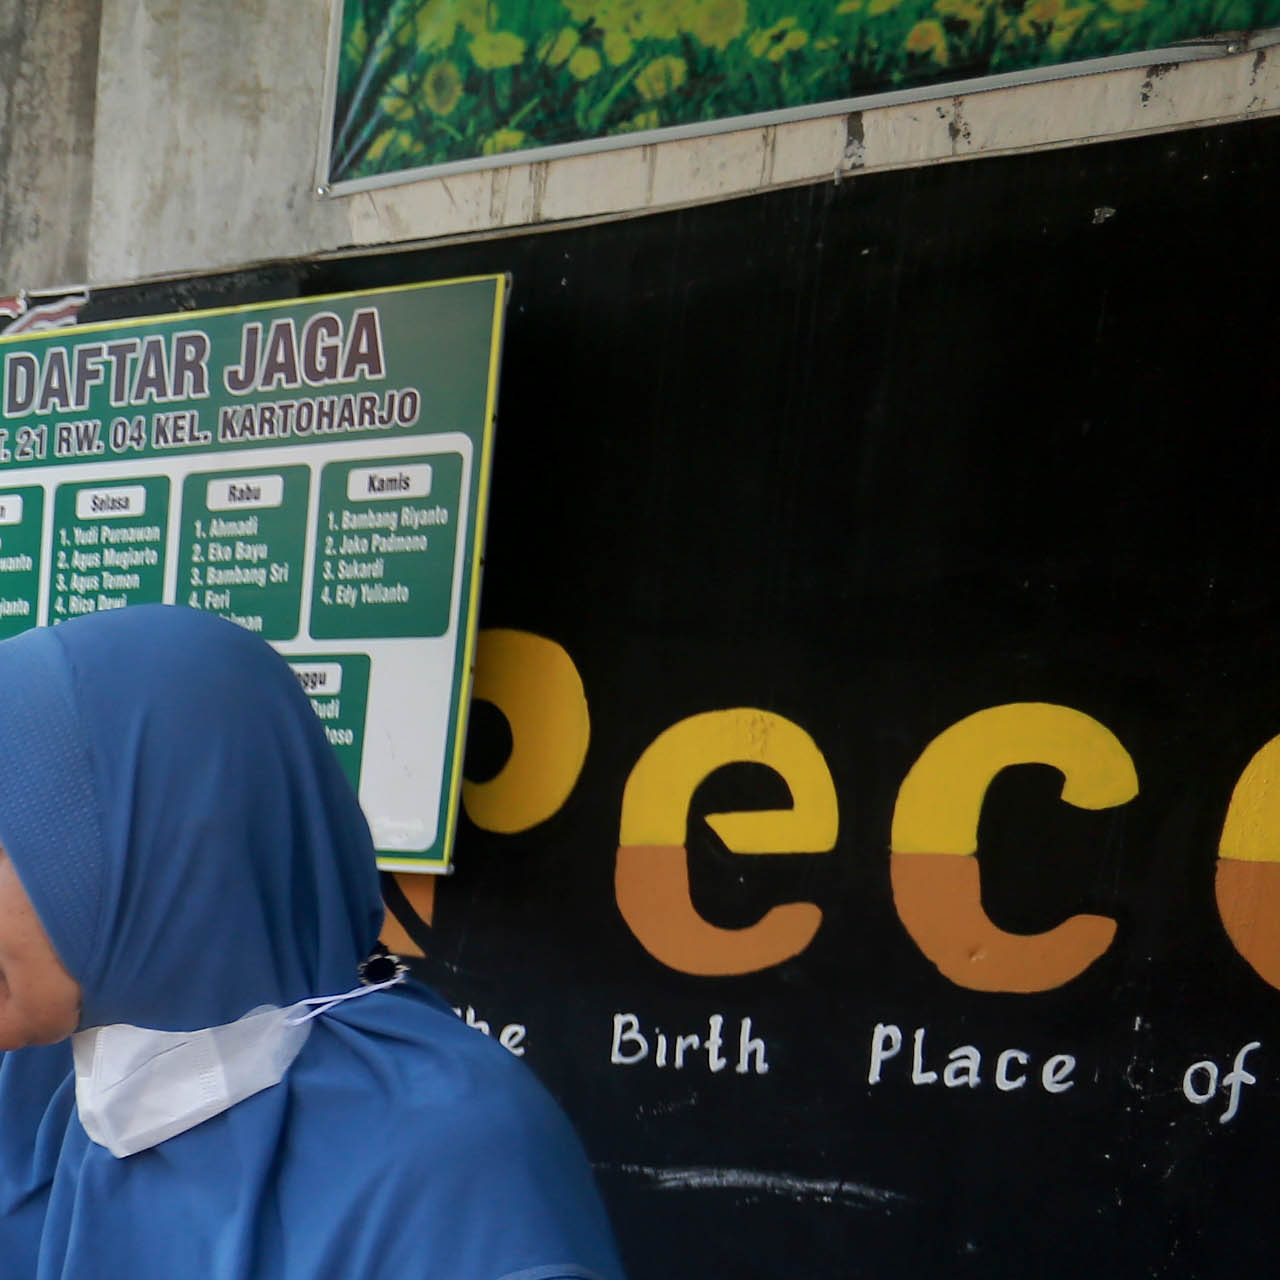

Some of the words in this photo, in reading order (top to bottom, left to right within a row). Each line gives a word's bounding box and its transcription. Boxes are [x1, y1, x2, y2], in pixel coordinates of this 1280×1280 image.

[4, 331, 209, 417] DAFTAR
[224, 308, 385, 395] JAGA
[16, 424, 46, 461] 21
[55, 420, 104, 456] RW.
[111, 417, 145, 453] 04
[152, 410, 211, 448] KEL.
[218, 388, 420, 442] KARTOHARJO
[228, 485, 261, 502] Rabu
[368, 474, 410, 493] Kamis
[327, 511, 338, 530] 1.
[341, 508, 398, 531] Bambang
[401, 506, 448, 529] Riyanto
[59, 530, 71, 546] 1.
[194, 521, 207, 538] 1.
[192, 544, 205, 563] 2.
[208, 542, 232, 562] Eko
[325, 536, 337, 555] 2.
[339, 535, 368, 555] Joko
[57, 553, 70, 569] 2.
[322, 562, 334, 580] 3.
[338, 559, 384, 579] Sukardi
[56, 576, 68, 592] 3.
[191, 568, 203, 586] 3.
[270, 564, 289, 582] Sri
[189, 592, 201, 609] 4.
[321, 587, 333, 605] 4.
[336, 584, 358, 607] Edy
[361, 583, 409, 604] Yulianto
[54, 597, 67, 614] 4.
[611, 1012, 769, 1074] Birth
[1182, 1040, 1261, 1123] of
